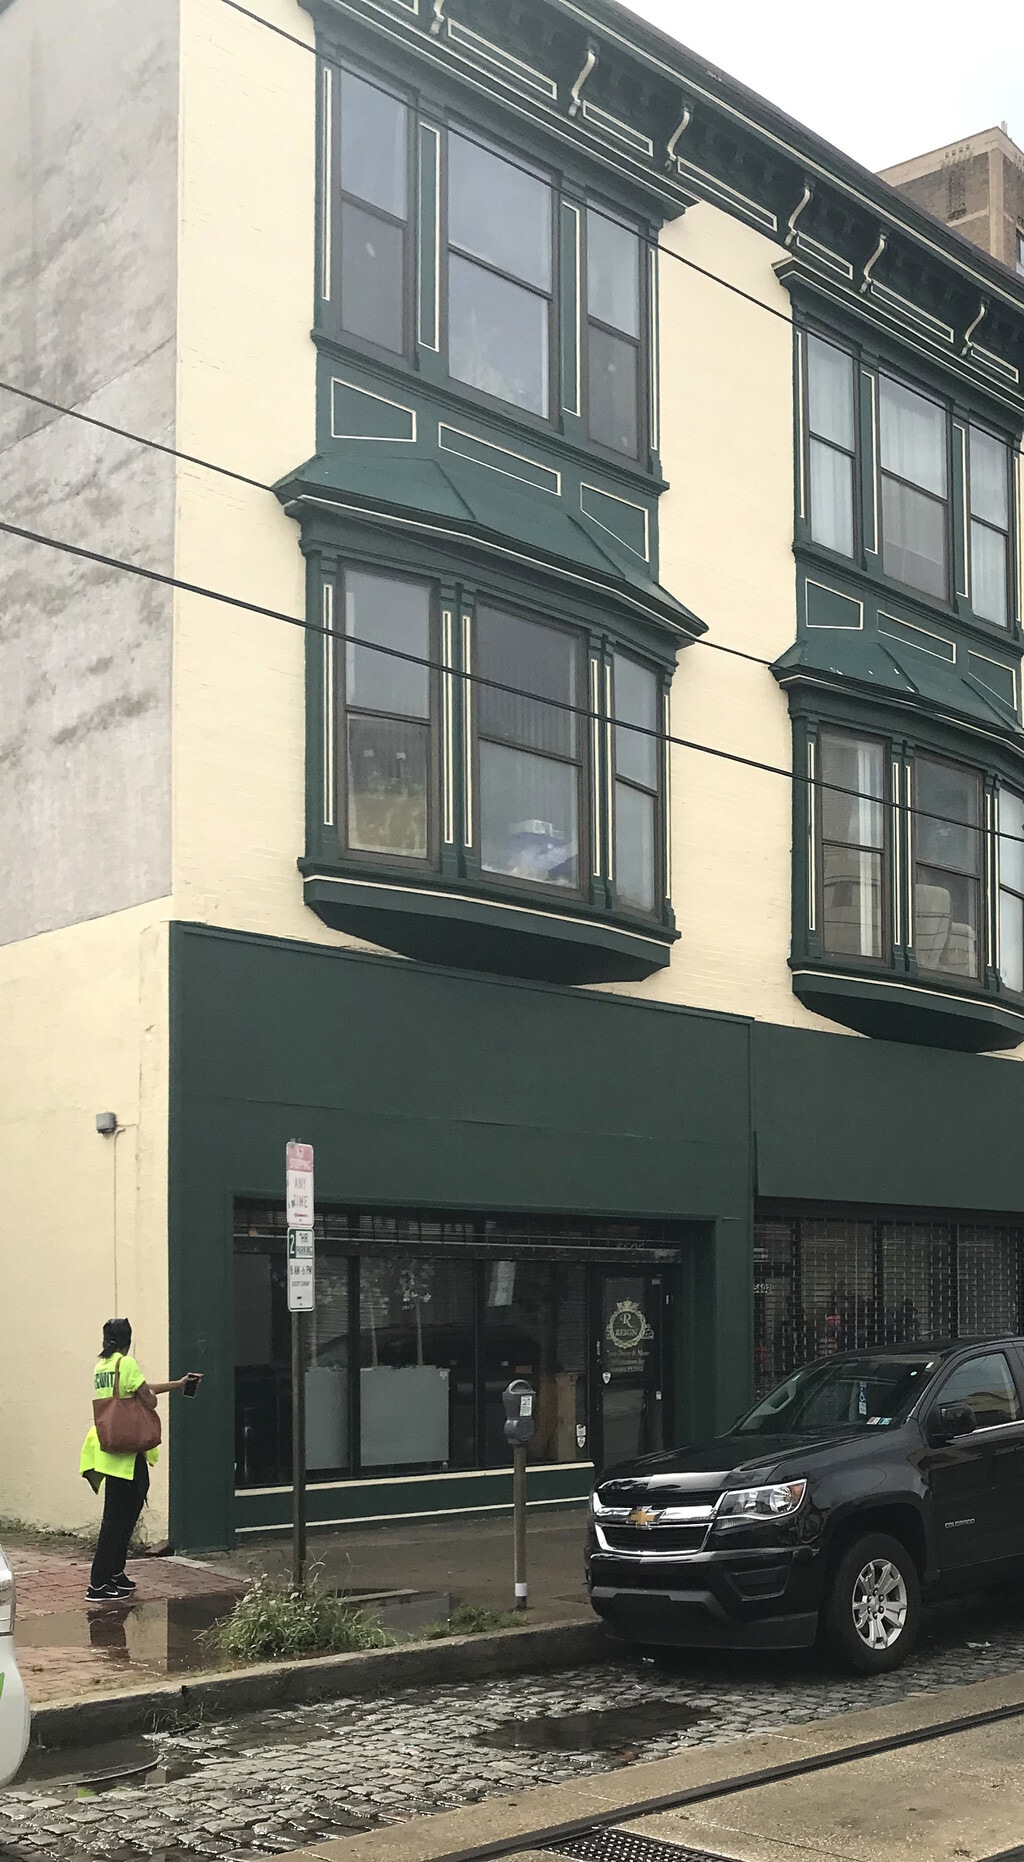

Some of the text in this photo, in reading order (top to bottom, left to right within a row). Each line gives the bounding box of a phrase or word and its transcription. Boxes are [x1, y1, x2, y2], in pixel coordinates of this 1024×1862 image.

[294, 1177, 307, 1190] ANY
[289, 1234, 295, 1254] 2
[615, 1329, 638, 1337] REIGN
